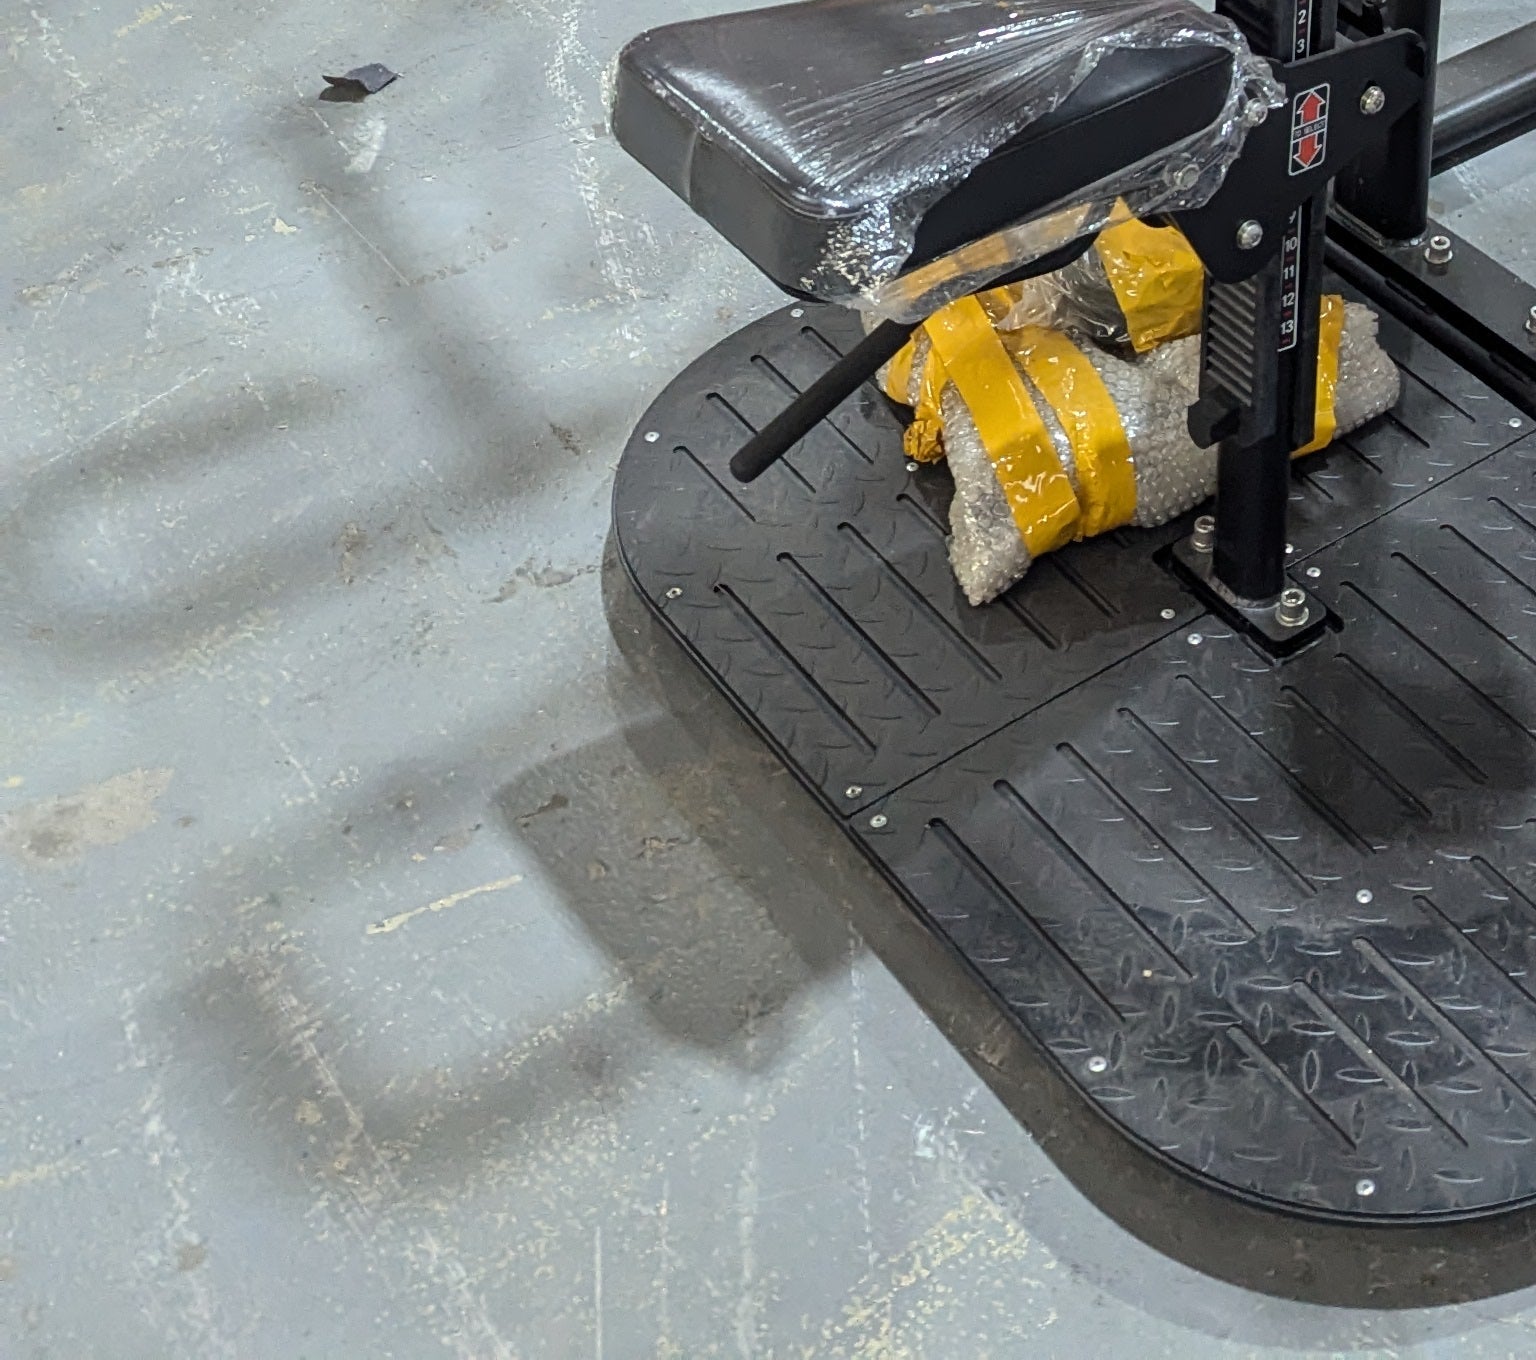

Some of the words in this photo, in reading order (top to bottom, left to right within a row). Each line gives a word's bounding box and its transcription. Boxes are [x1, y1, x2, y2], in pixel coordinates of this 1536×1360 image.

[1298, 9, 1307, 25] 2
[1296, 38, 1305, 54] 3
[1285, 236, 1297, 253] 10
[1283, 264, 1295, 280] 11
[1282, 291, 1295, 308] 12
[1280, 319, 1294, 335] 13
